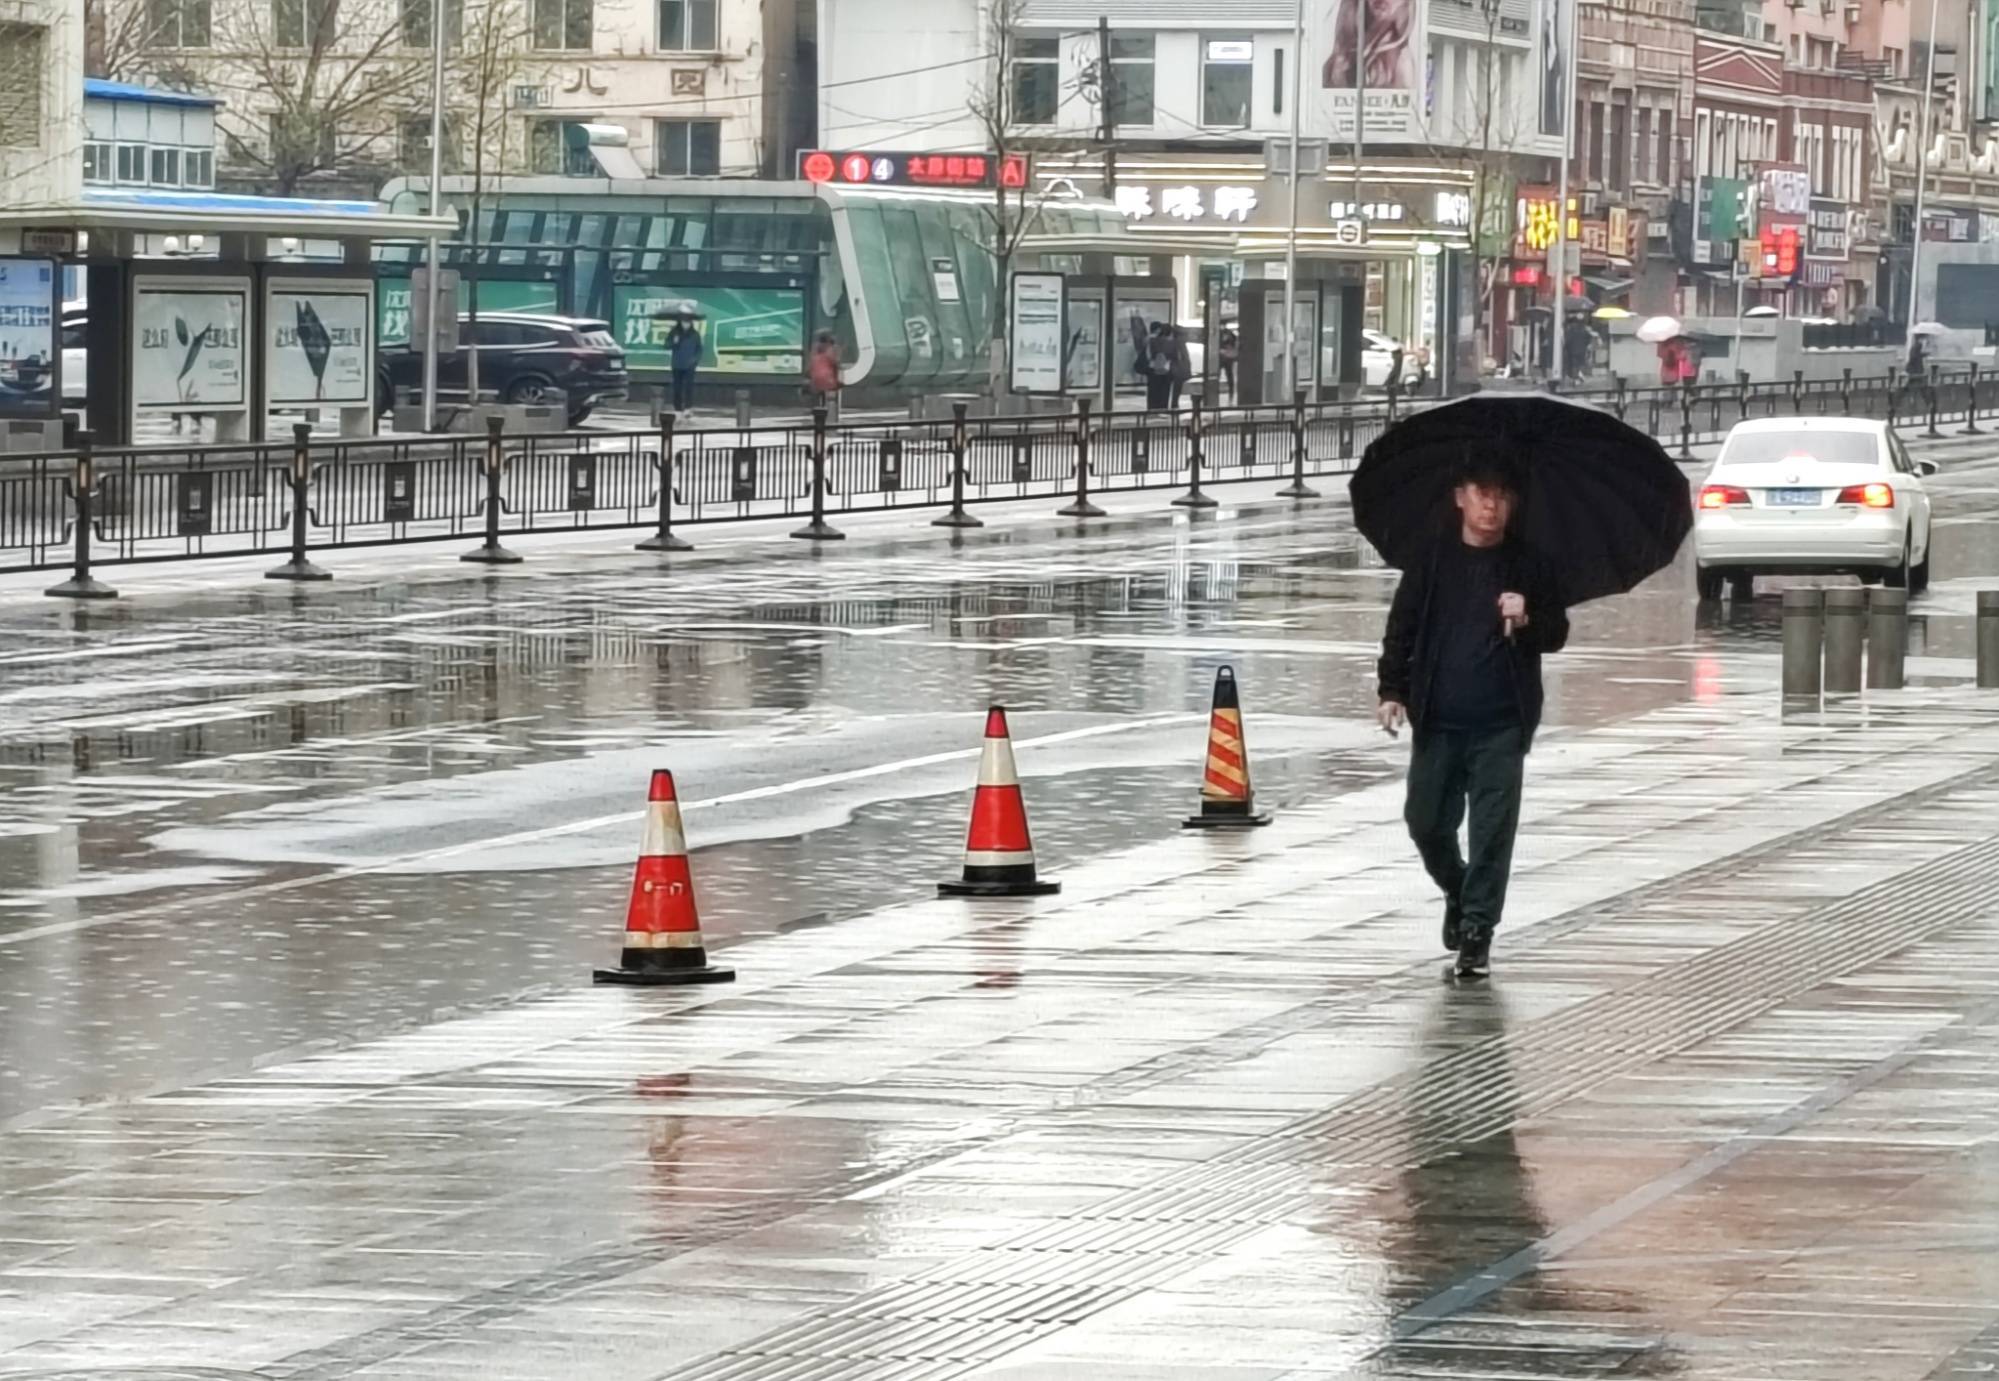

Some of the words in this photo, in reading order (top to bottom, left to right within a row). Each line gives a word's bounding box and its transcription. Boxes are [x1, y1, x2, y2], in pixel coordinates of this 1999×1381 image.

[849, 158, 861, 180] 1
[873, 158, 888, 180] 4
[1002, 160, 1021, 185] A
